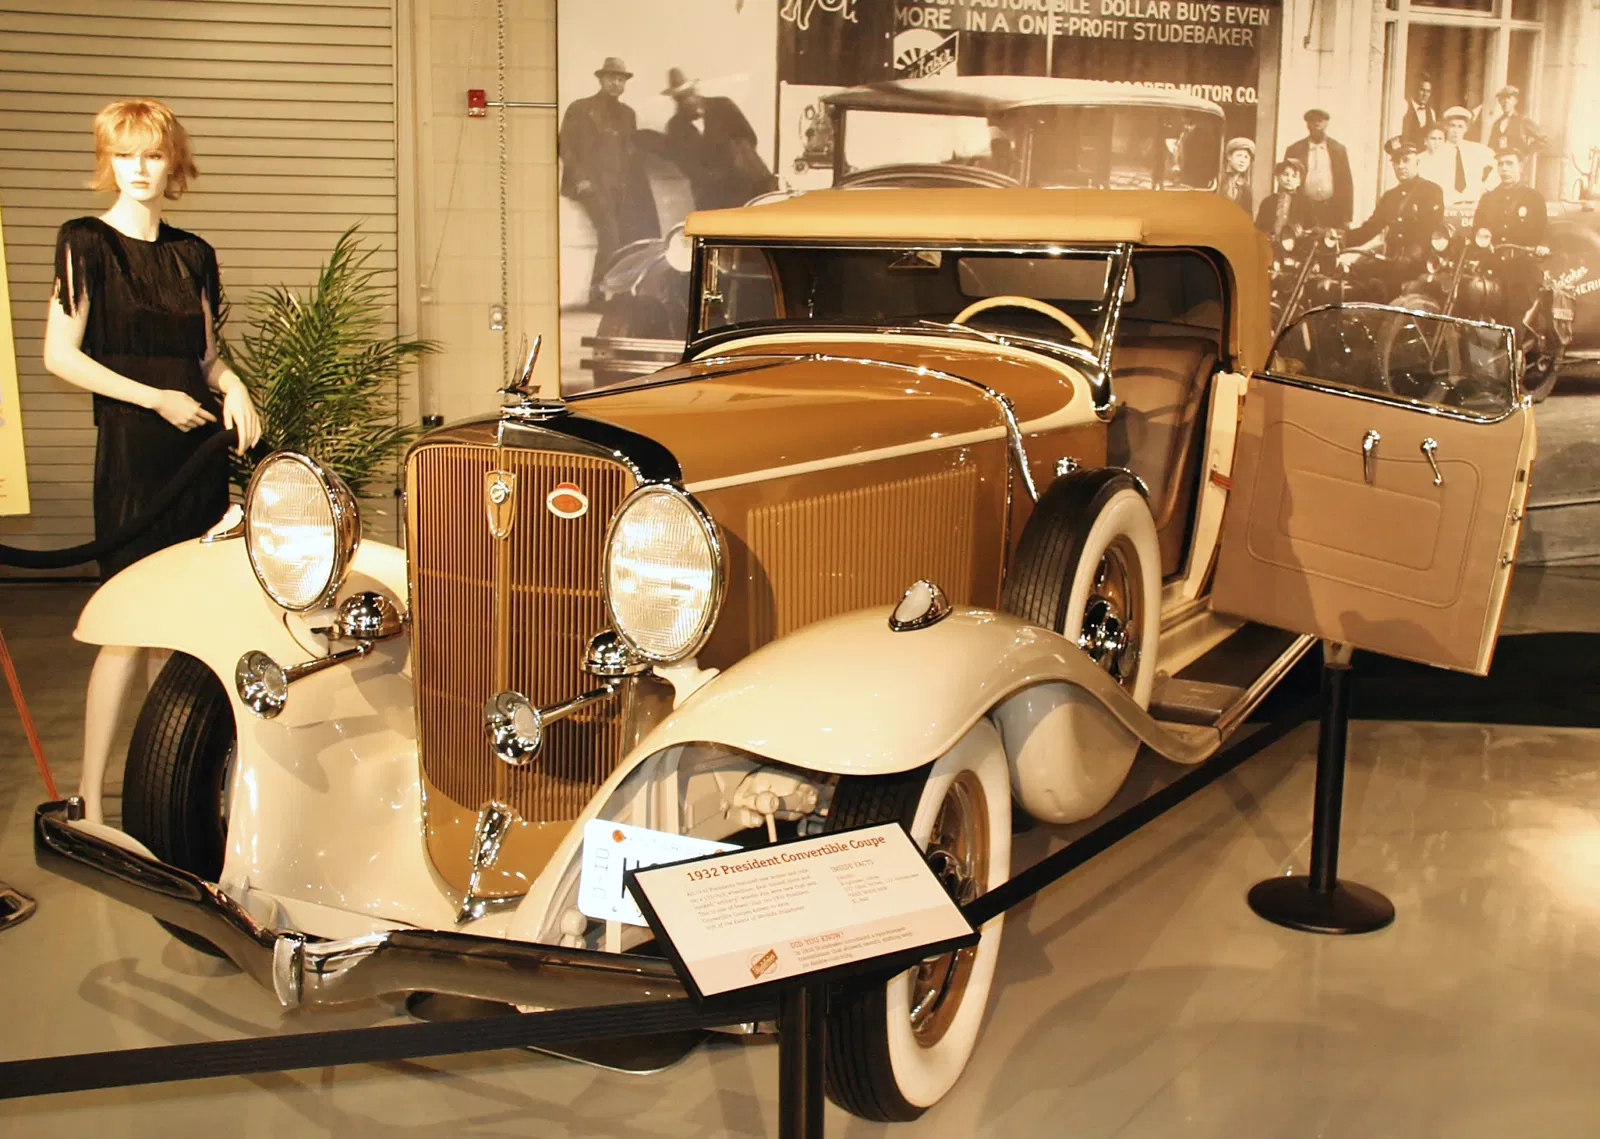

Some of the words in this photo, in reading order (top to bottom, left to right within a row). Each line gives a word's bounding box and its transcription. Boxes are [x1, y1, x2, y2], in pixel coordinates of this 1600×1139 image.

[1100, 0, 1170, 19] DOLLAR
[1177, 3, 1221, 23] BUYS
[1225, 5, 1270, 26] EVEN
[894, 7, 952, 29] MORE
[966, 10, 987, 31] IN
[991, 13, 1010, 33] A
[1018, 14, 1128, 39] ONE-PROFIT
[1133, 22, 1254, 47] STUDEBAKER
[1236, 86, 1259, 104] CO.
[686, 867, 719, 882] 1932
[721, 856, 781, 875] President
[781, 842, 848, 863] Convertible
[849, 835, 886, 852] Coupe
[806, 937, 820, 946] YOU
